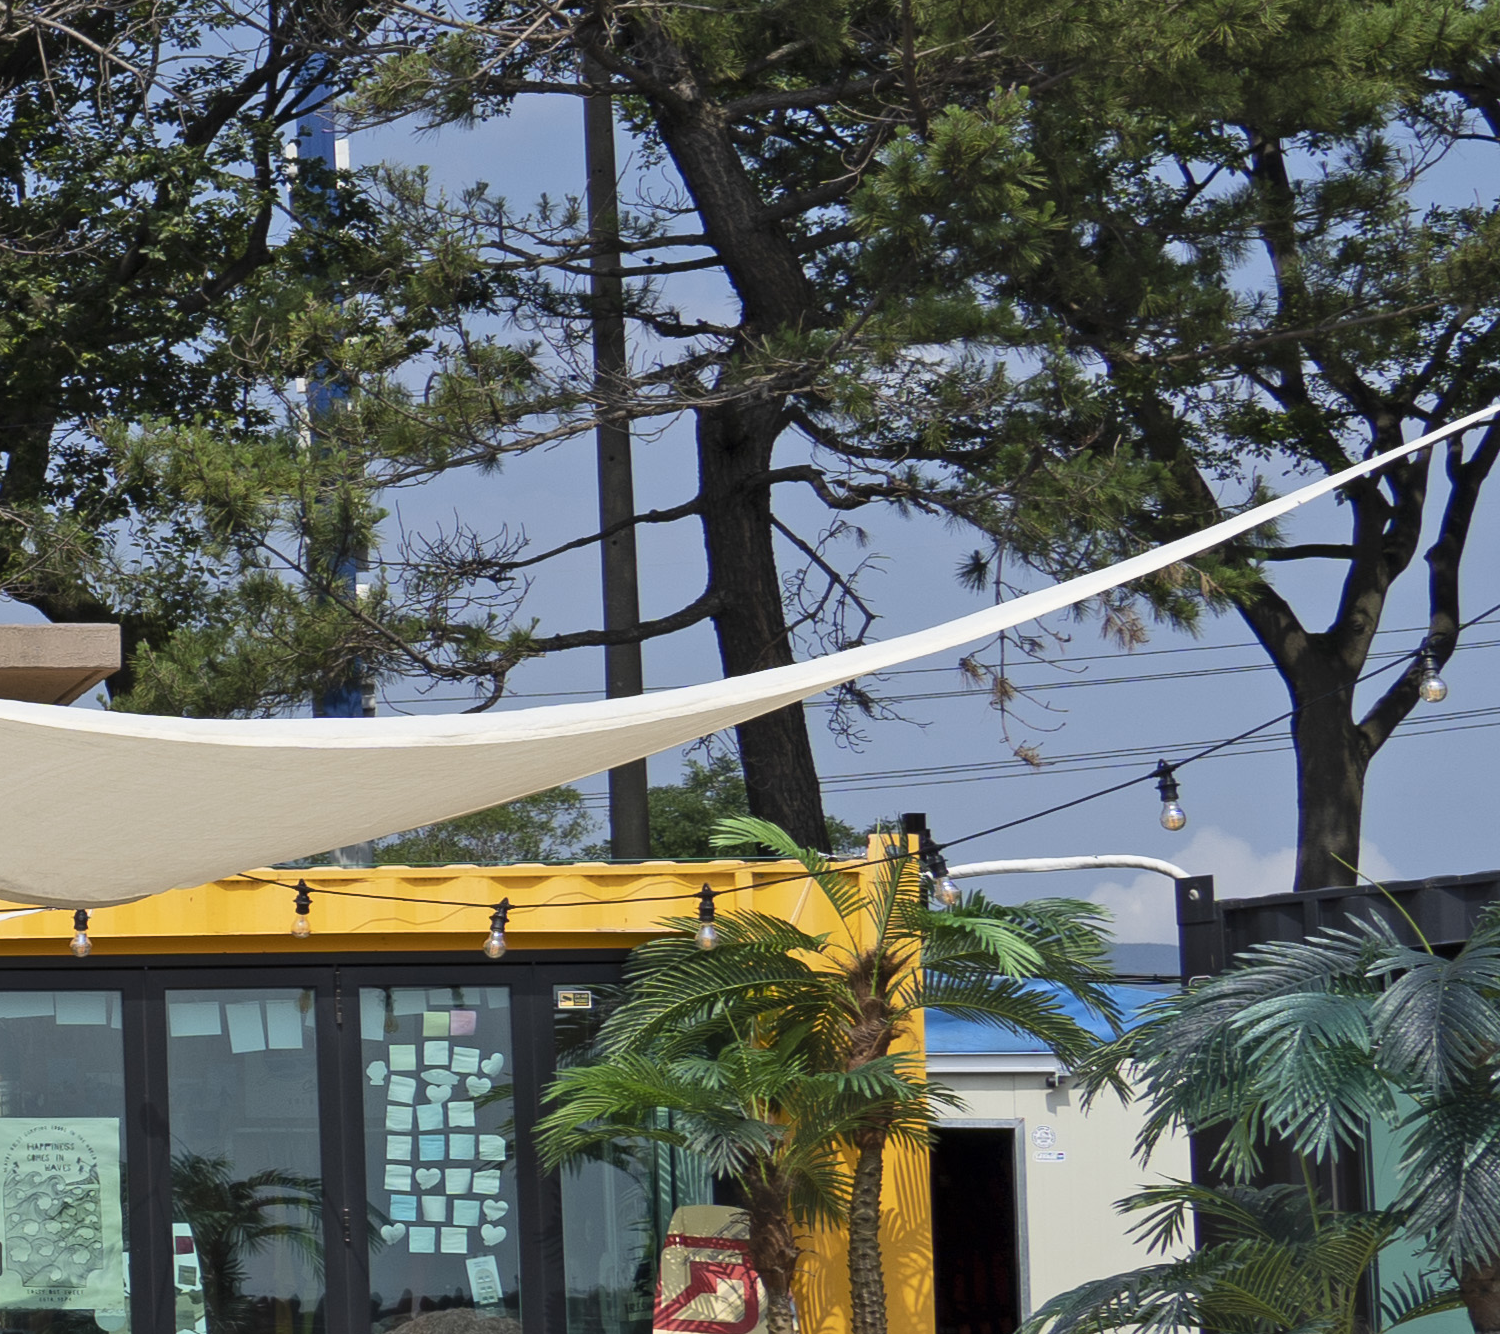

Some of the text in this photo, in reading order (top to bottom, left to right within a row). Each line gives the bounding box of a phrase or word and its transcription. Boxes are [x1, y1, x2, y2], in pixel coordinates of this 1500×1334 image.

[26, 1142, 75, 1151] HAPPINESS
[26, 1154, 65, 1163] COMES IN
[44, 1163, 72, 1172] WAVES
